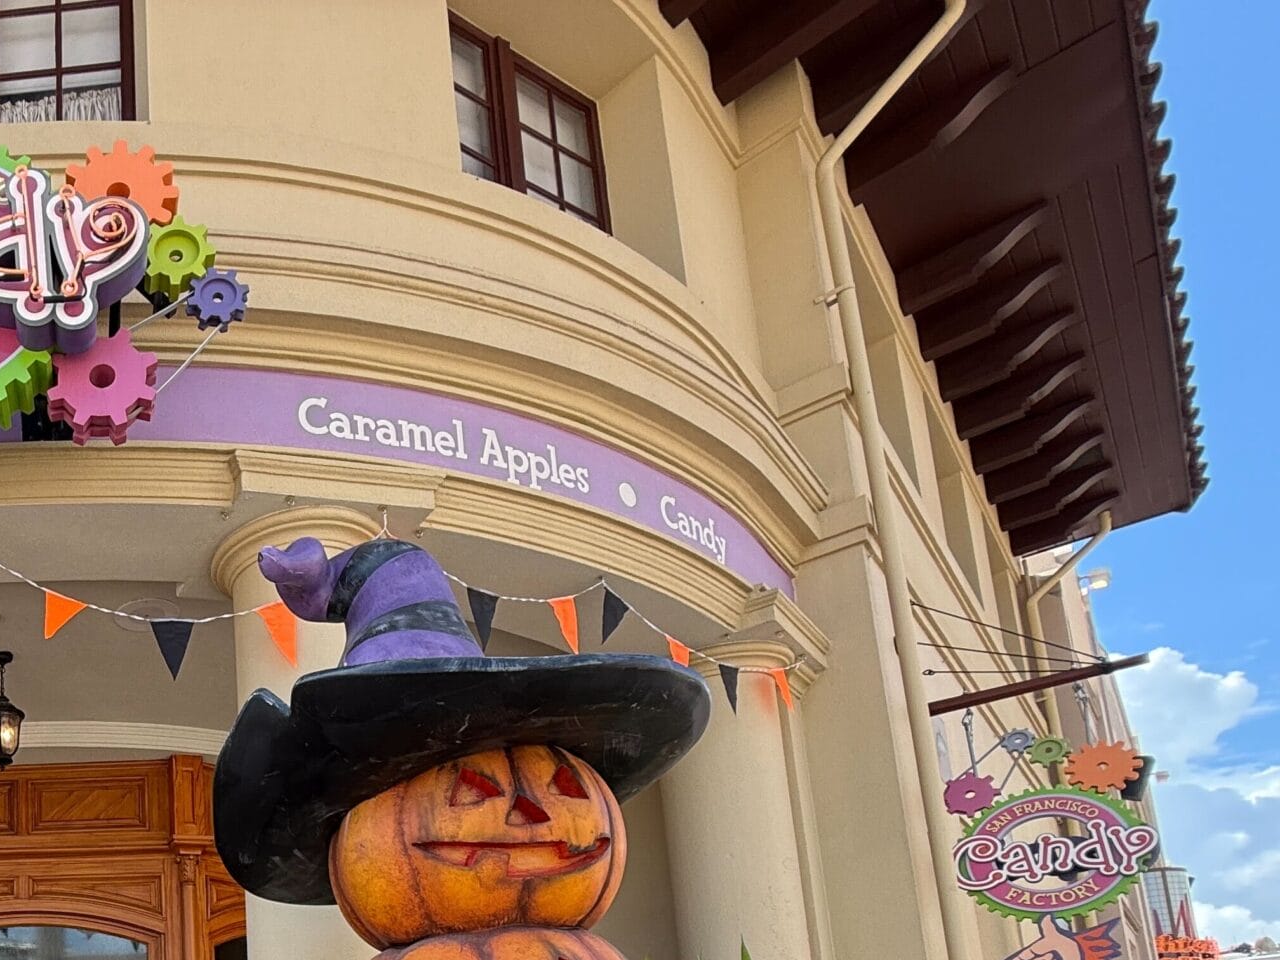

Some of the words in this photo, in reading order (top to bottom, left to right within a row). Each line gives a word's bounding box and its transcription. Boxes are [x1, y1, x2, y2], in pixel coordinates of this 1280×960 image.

[298, 397, 468, 460] Caramel
[480, 428, 590, 491] Apples
[660, 495, 726, 565] Candy
[985, 813, 1013, 834] SAN
[1015, 799, 1100, 819] FRANCISCO
[953, 820, 1159, 891] Candy
[1004, 879, 1101, 906] FACTORY
